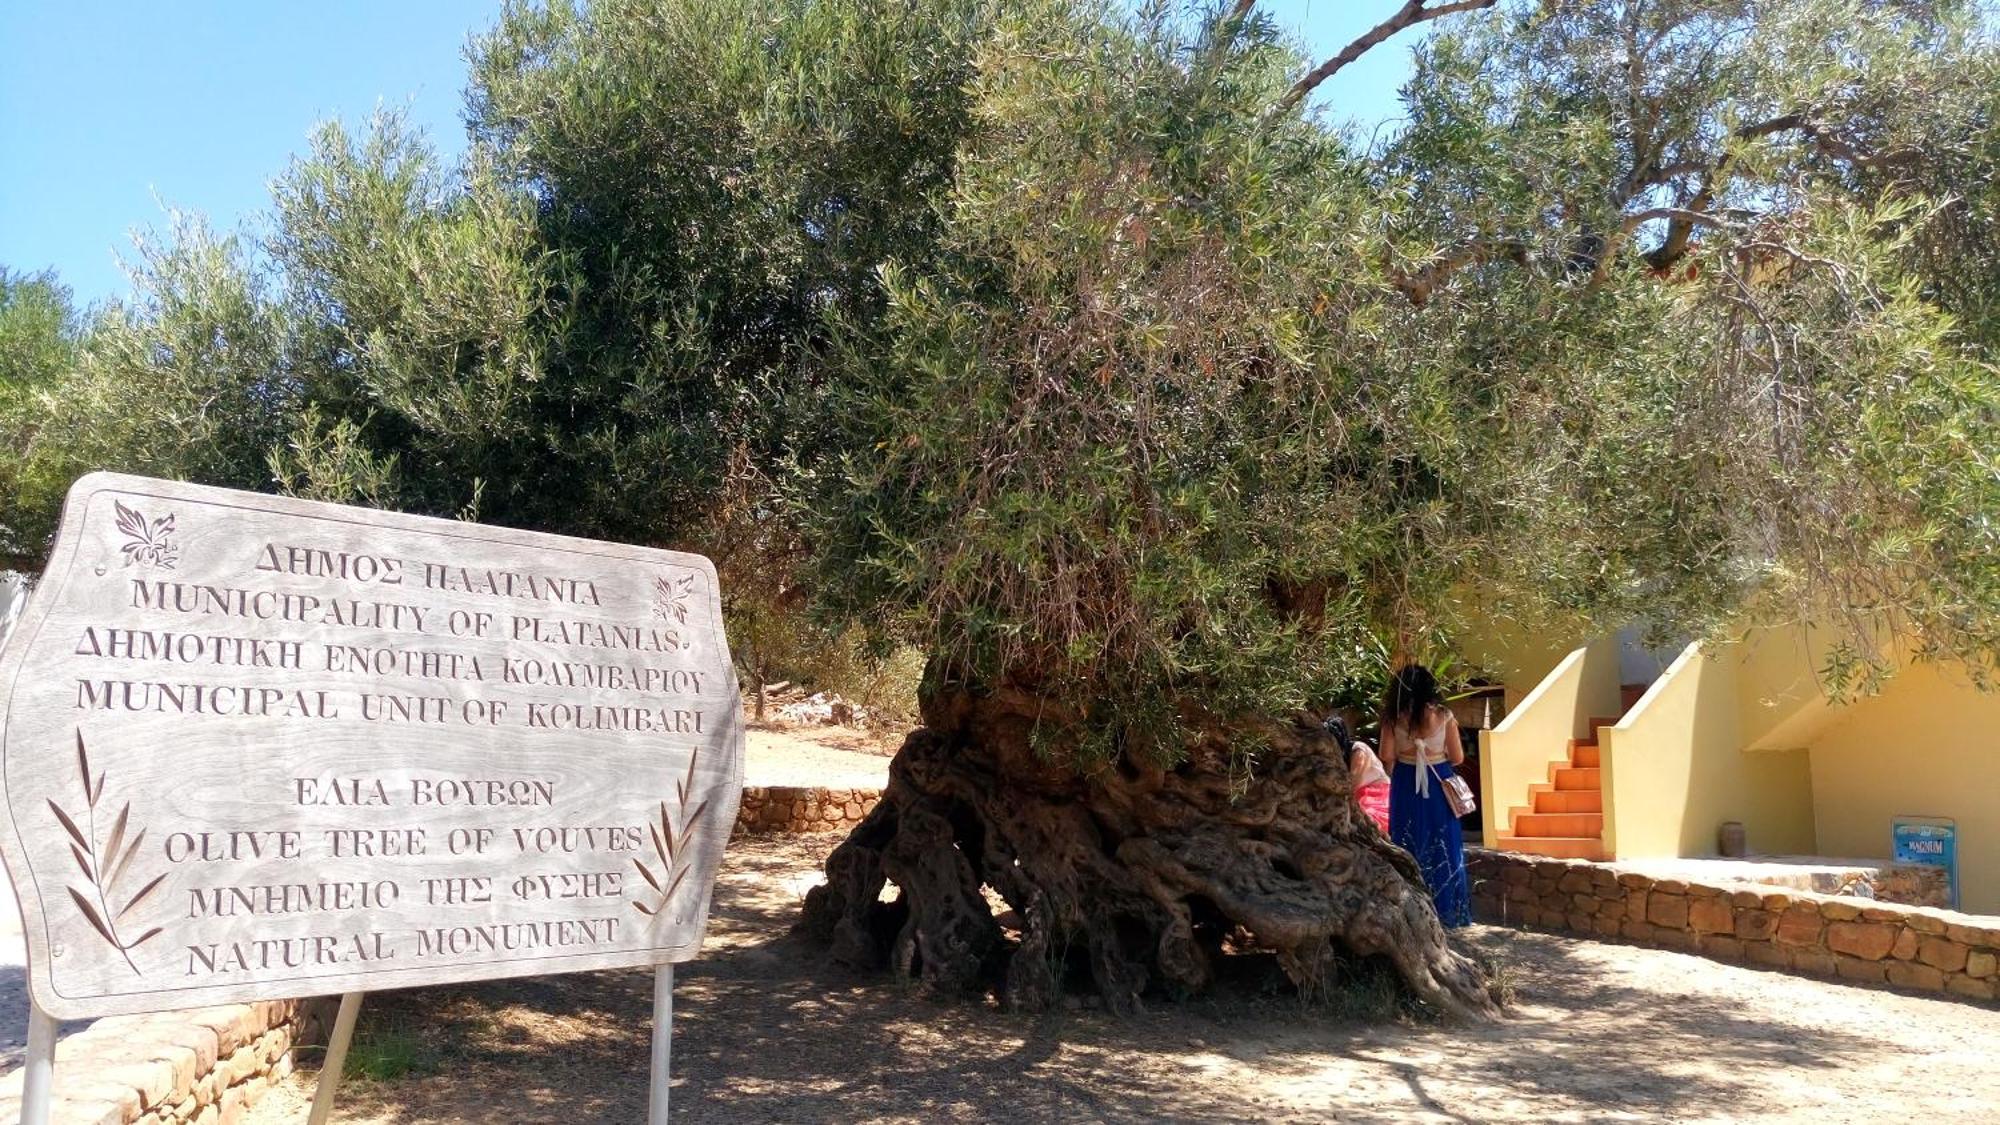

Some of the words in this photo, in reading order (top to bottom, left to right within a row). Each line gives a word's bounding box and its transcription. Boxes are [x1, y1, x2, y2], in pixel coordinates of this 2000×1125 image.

[255, 543, 402, 584] ΔΗΜΟΣ
[424, 563, 600, 606] ΠΛΑΤΑΝΙΑ
[132, 578, 430, 633] MUNICIPALITY
[448, 610, 493, 637] OF
[510, 615, 680, 652] PLATANIAS
[75, 626, 305, 669] ΔΗΜΟΤΙΚΗ
[322, 644, 484, 681] ΕΝΟΤΗΤΑ
[502, 657, 705, 694] ΚΟΛΥΜΒΑΡΙΟΥ
[77, 679, 338, 719] MUNICIPAL
[361, 694, 453, 723] UNIT
[462, 699, 508, 726] OF
[526, 703, 704, 734] KOLIMBARI
[293, 777, 391, 806] ΕΛΙΑ
[409, 778, 553, 807] ΒΟΥΒΩΝ
[164, 832, 301, 863] OLIVE
[324, 828, 426, 858] TREE
[448, 828, 494, 855] OF
[511, 825, 643, 852] VOUVES
[1908, 840, 1943, 854] MAGNUM
[186, 880, 399, 919] ΜΝΗΜΕΙΟ
[420, 877, 492, 905] ΤΗΣ
[511, 872, 623, 901] ΦΥΣΗΣ
[185, 932, 394, 976] NATURAL
[416, 917, 620, 957] MONUMENT
